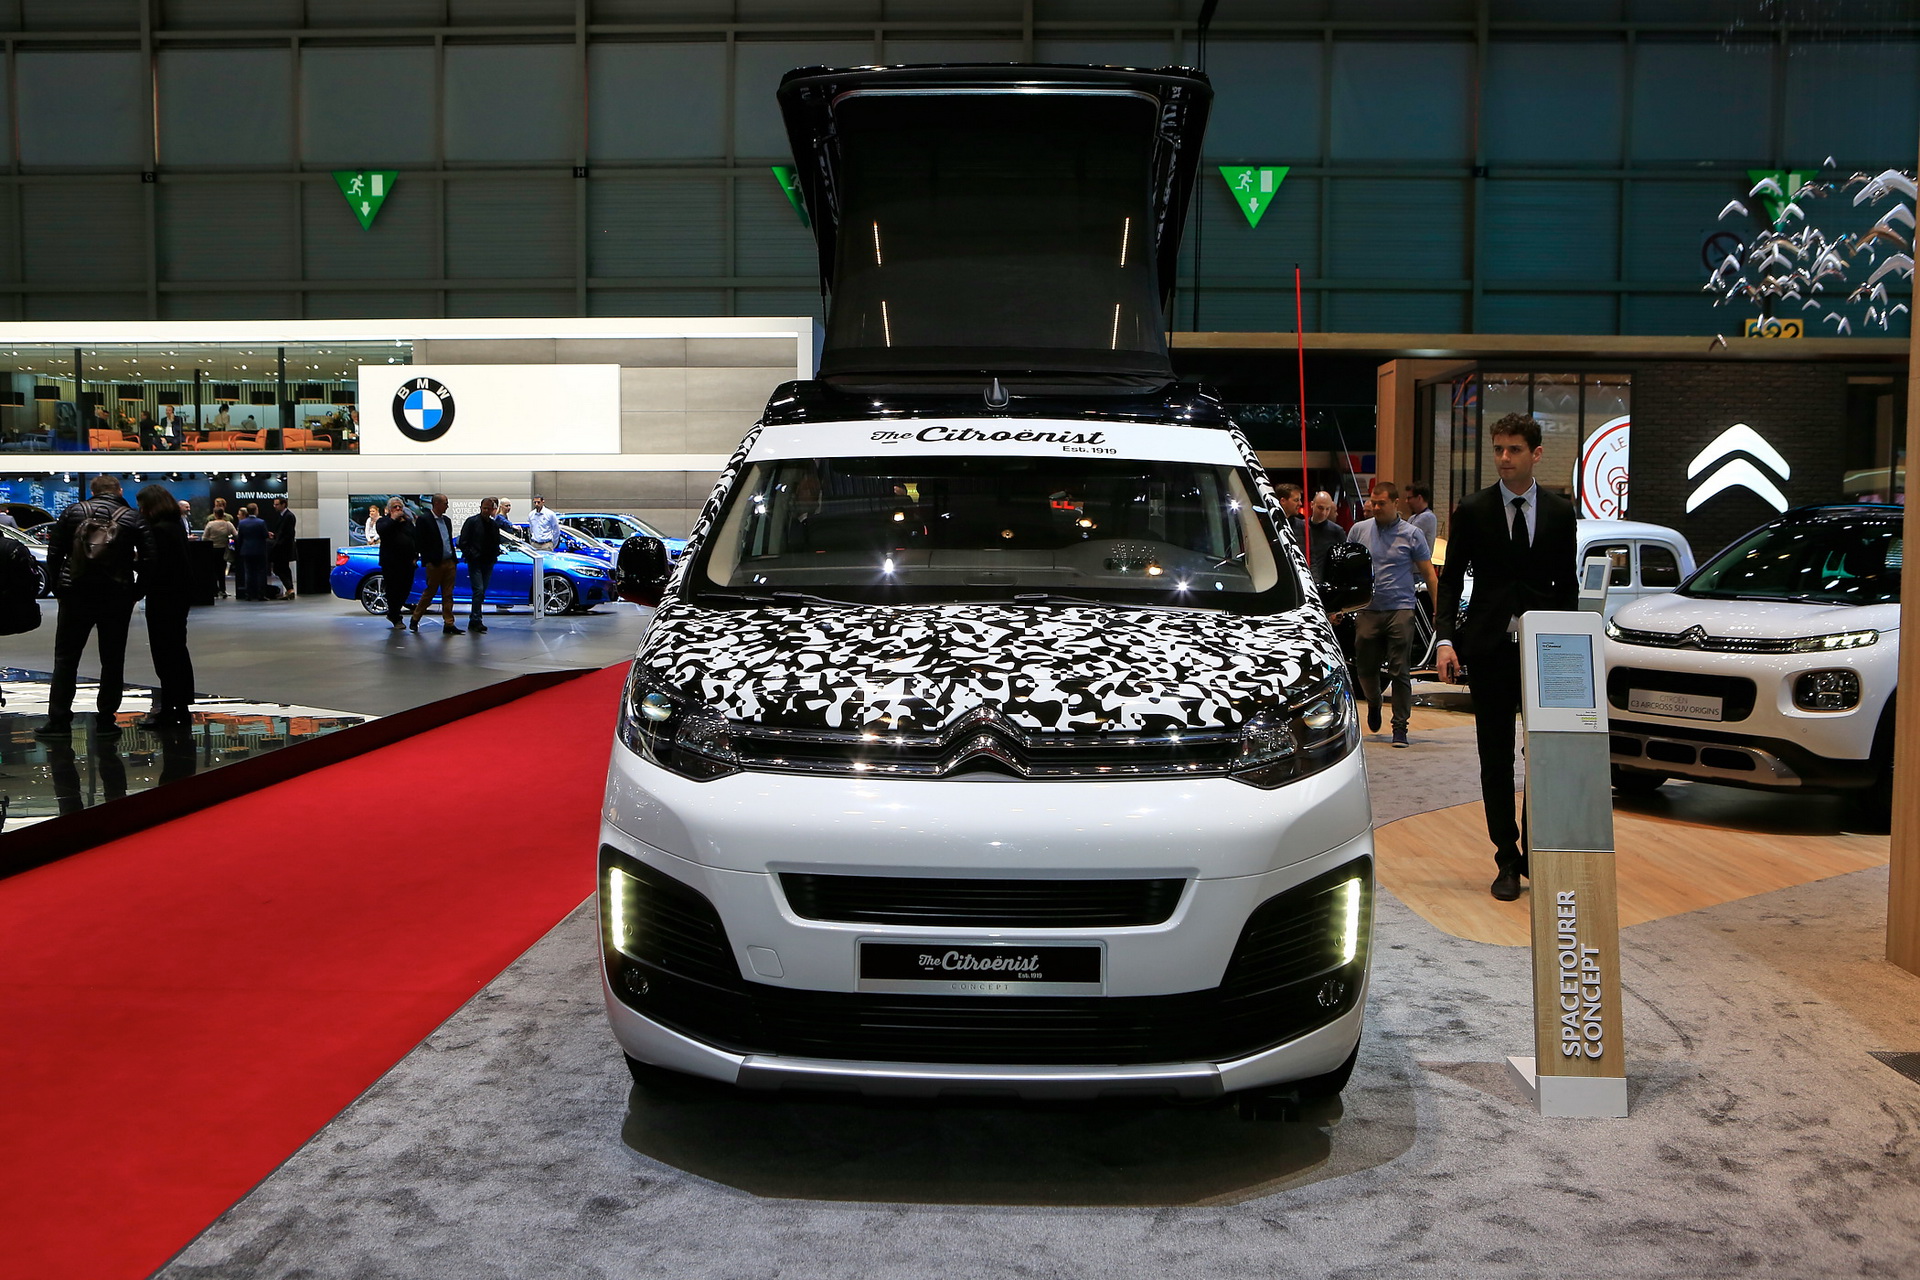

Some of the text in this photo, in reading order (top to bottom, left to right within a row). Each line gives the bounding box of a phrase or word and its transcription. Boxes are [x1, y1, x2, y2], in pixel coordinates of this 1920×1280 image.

[145, 172, 153, 182] G
[577, 167, 585, 177] H
[397, 378, 450, 400] BMW
[870, 425, 1106, 445] The Citroënist
[1062, 445, 1117, 455] Est. 1919
[1610, 436, 1627, 452] LE
[235, 491, 256, 499] BMW
[1630, 700, 1720, 716] C3 AIRCROSS SUV ORIGINS
[918, 951, 1040, 971] The Citroënist
[1556, 890, 1581, 1058] SPACETOURER
[951, 983, 1009, 991] CONCEPT
[1580, 943, 1604, 1059] CONCEPT
